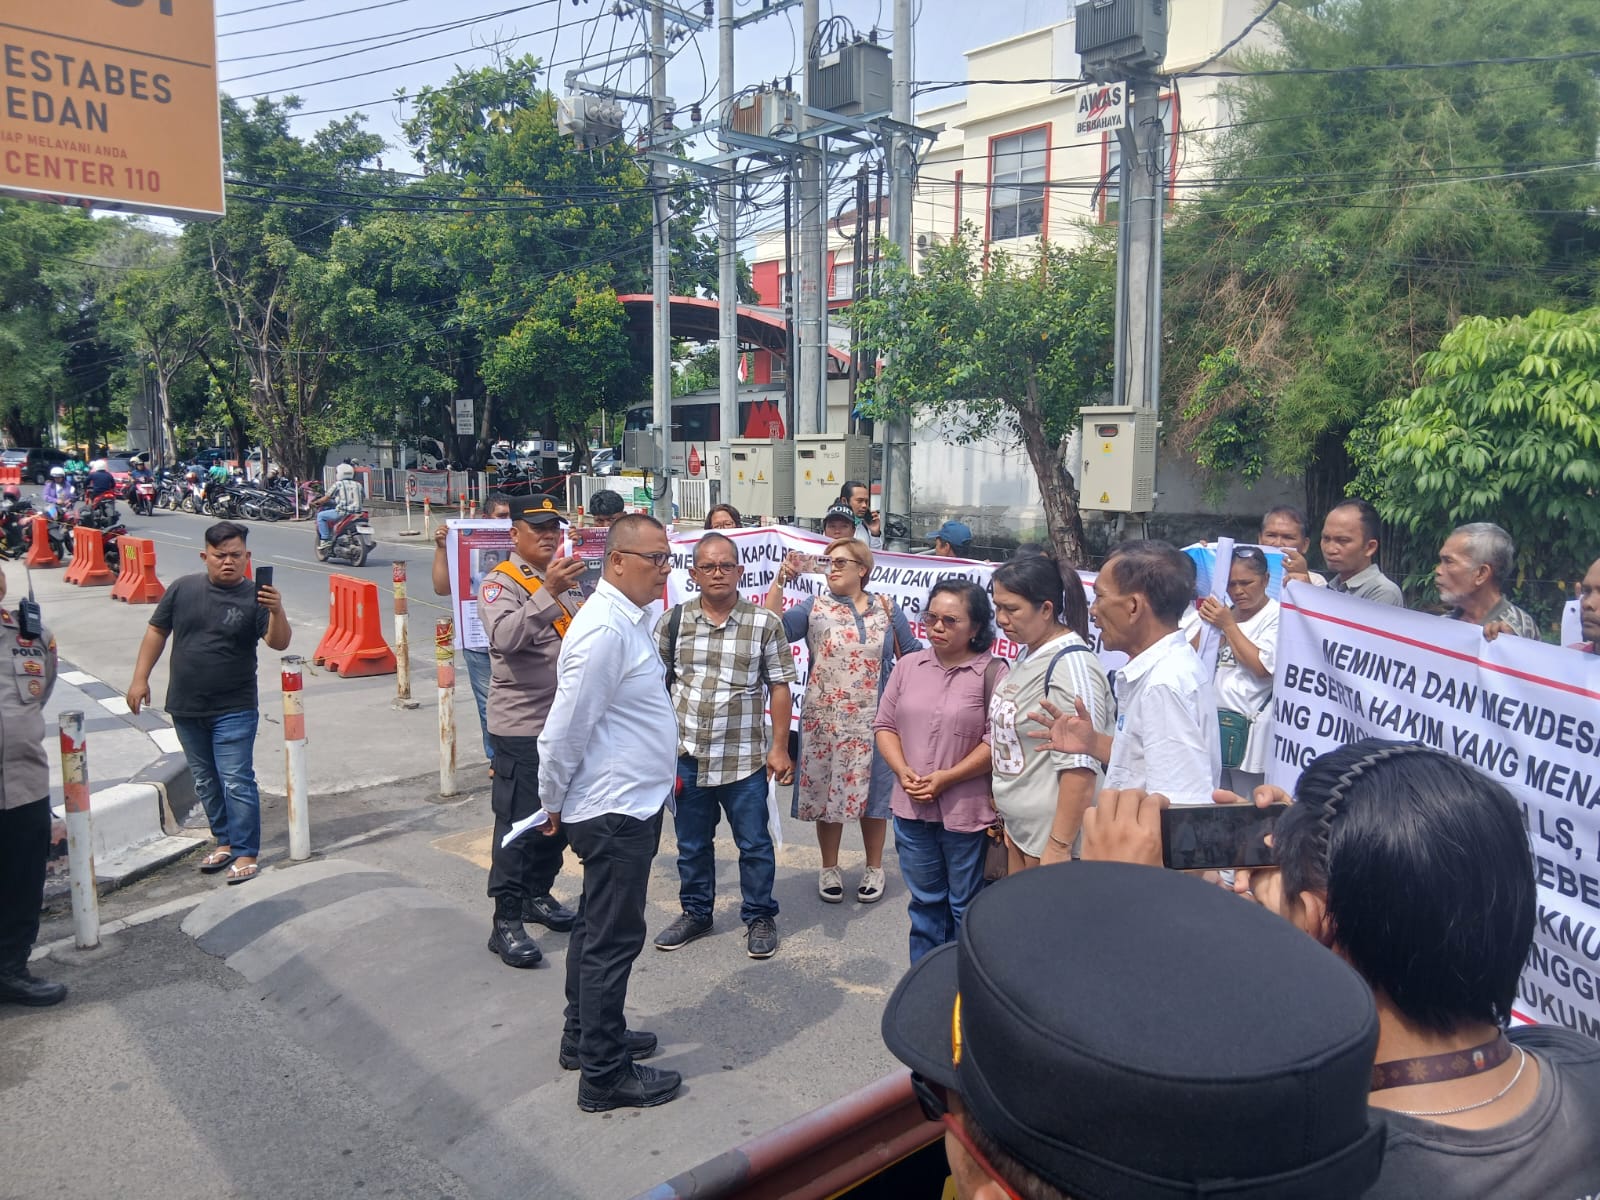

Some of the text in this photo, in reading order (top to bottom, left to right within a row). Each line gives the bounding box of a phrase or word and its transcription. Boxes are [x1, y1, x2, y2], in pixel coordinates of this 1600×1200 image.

[4, 44, 172, 104] ESTABES
[6, 86, 108, 133] EDAN
[1079, 87, 1121, 113] AWAS
[1077, 115, 1122, 133] BERBAHAYA
[28, 136, 91, 153] MELAYANI
[95, 147, 128, 159] ANDA
[5, 150, 160, 192] CENTER 110
[901, 570, 934, 588] DAN
[1322, 638, 1416, 694] MEMINTA
[1421, 671, 1477, 713] DAN
[1284, 664, 1365, 718] BESERTA
[1369, 696, 1443, 748] HAKIM
[1452, 726, 1519, 777] YANG
